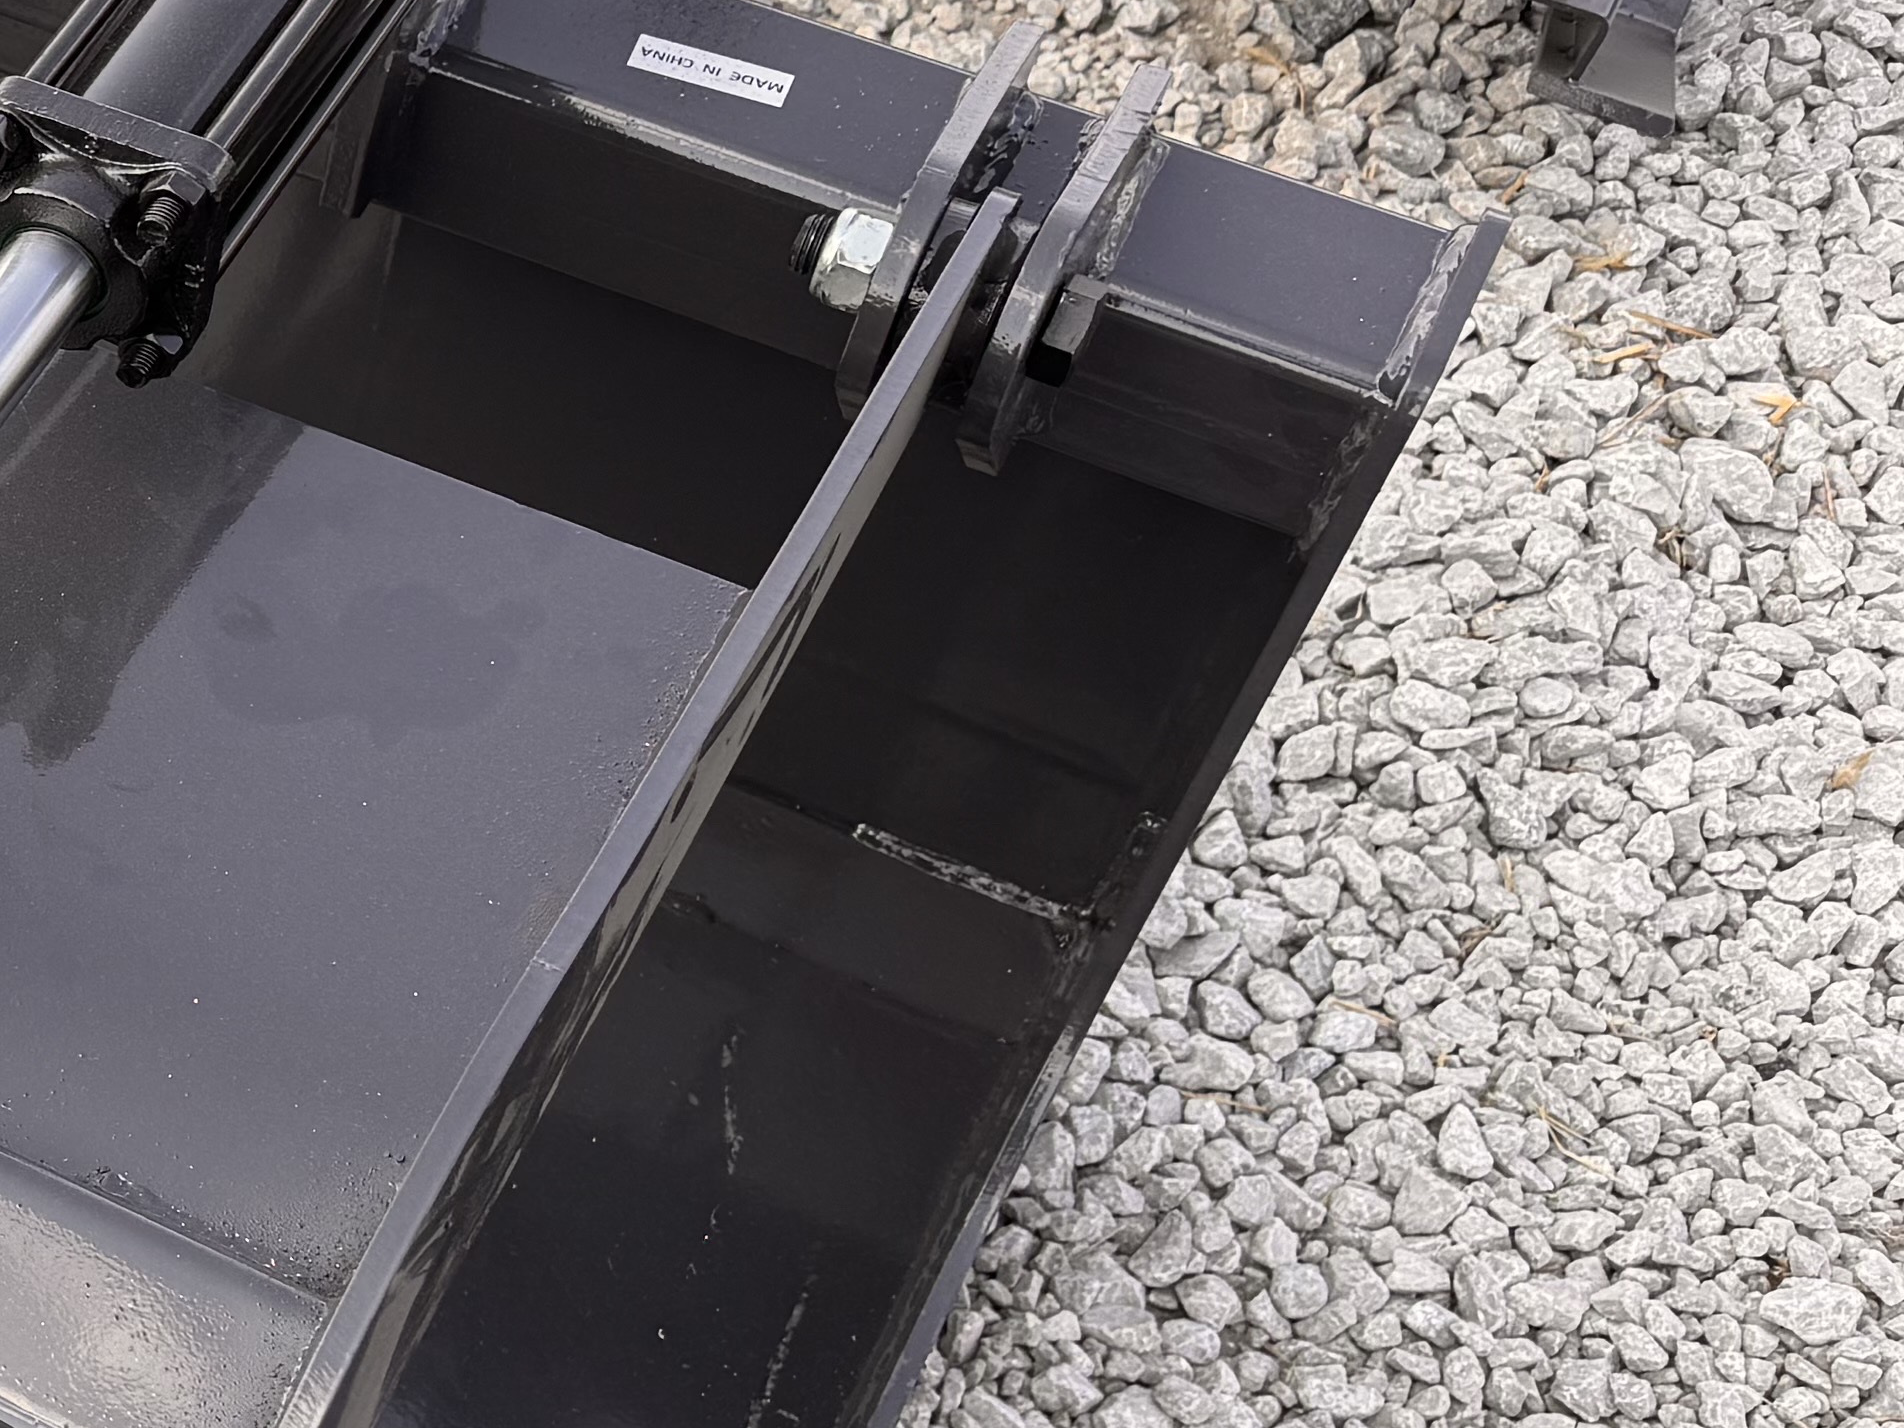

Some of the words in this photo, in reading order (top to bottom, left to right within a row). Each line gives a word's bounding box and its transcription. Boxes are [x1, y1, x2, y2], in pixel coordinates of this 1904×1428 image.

[641, 45, 694, 68] CHINA
[703, 63, 721, 76] IN
[729, 70, 784, 94] MADE
